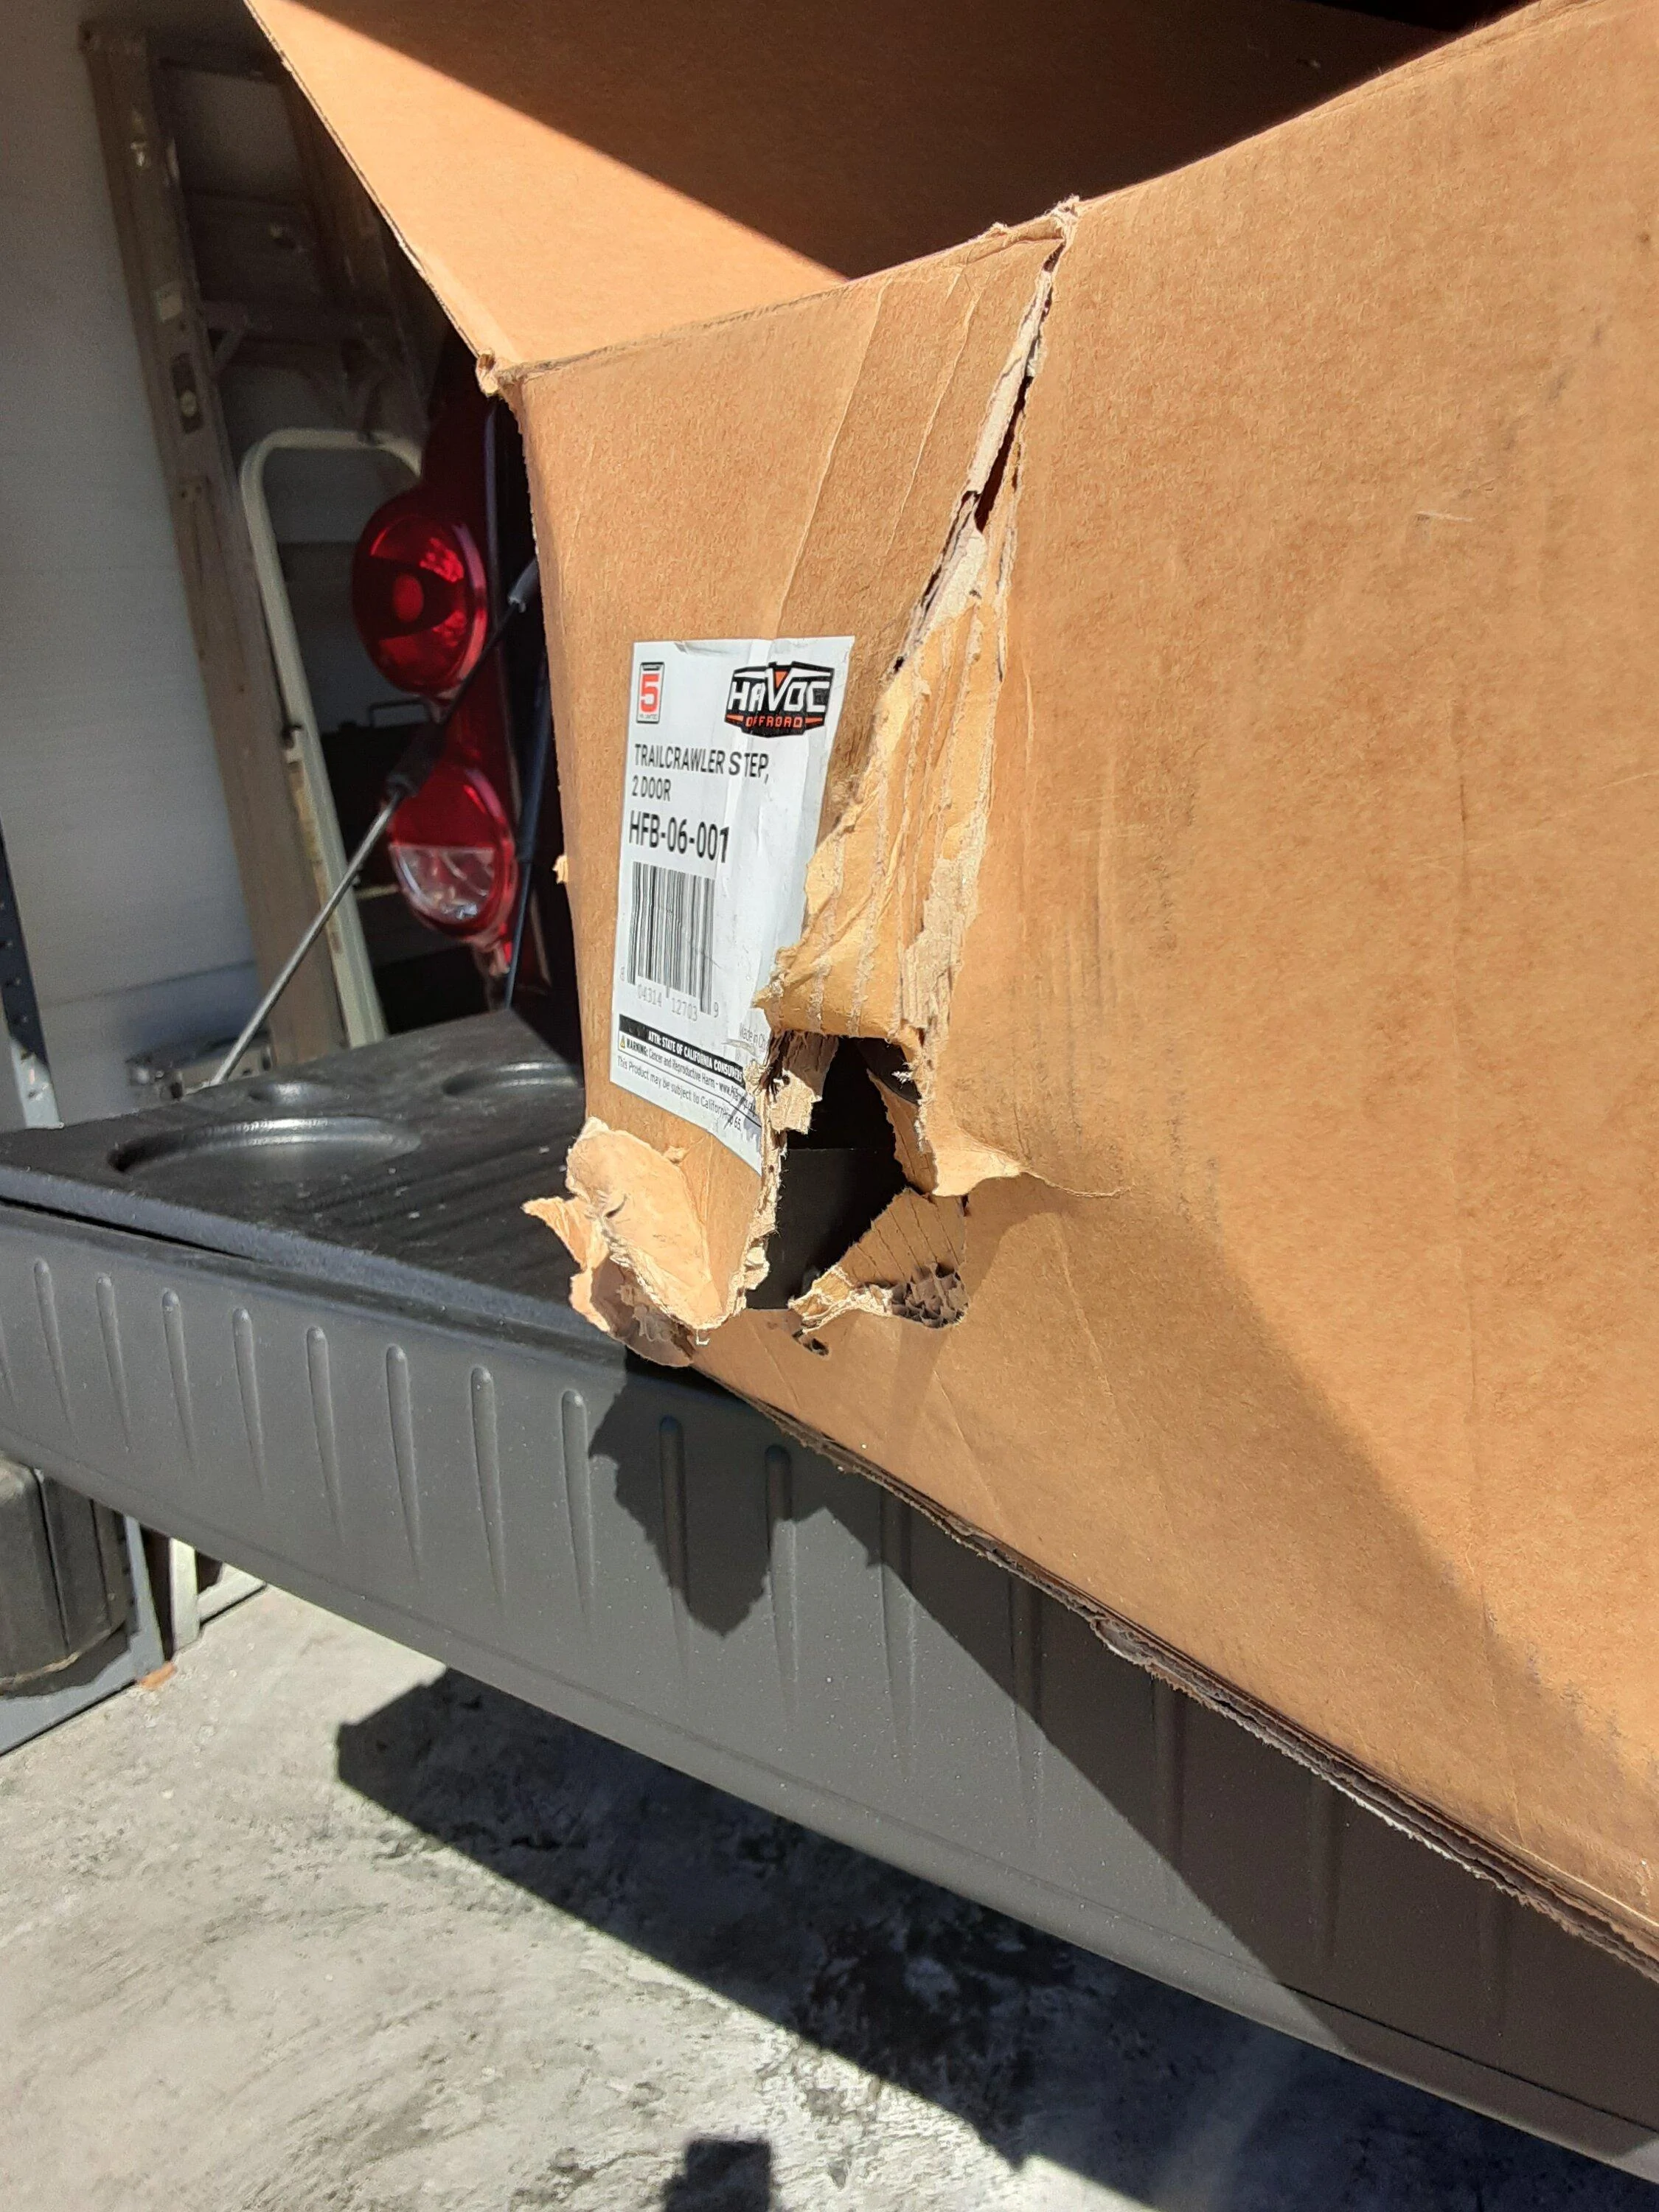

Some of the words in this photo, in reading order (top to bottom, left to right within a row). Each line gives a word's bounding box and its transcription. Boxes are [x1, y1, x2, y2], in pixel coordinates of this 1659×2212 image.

[640, 673, 658, 713] 5
[726, 667, 831, 712] HAVOC
[745, 715, 803, 729] OFFROAD
[634, 743, 726, 774] TRAILCRAWLER
[728, 751, 770, 785] STEP,
[632, 776, 639, 796] 2
[641, 777, 672, 801] DOOR
[629, 810, 729, 863] HFB-06-001
[714, 1001, 719, 1018] 9
[662, 1037, 675, 1052] STATE
